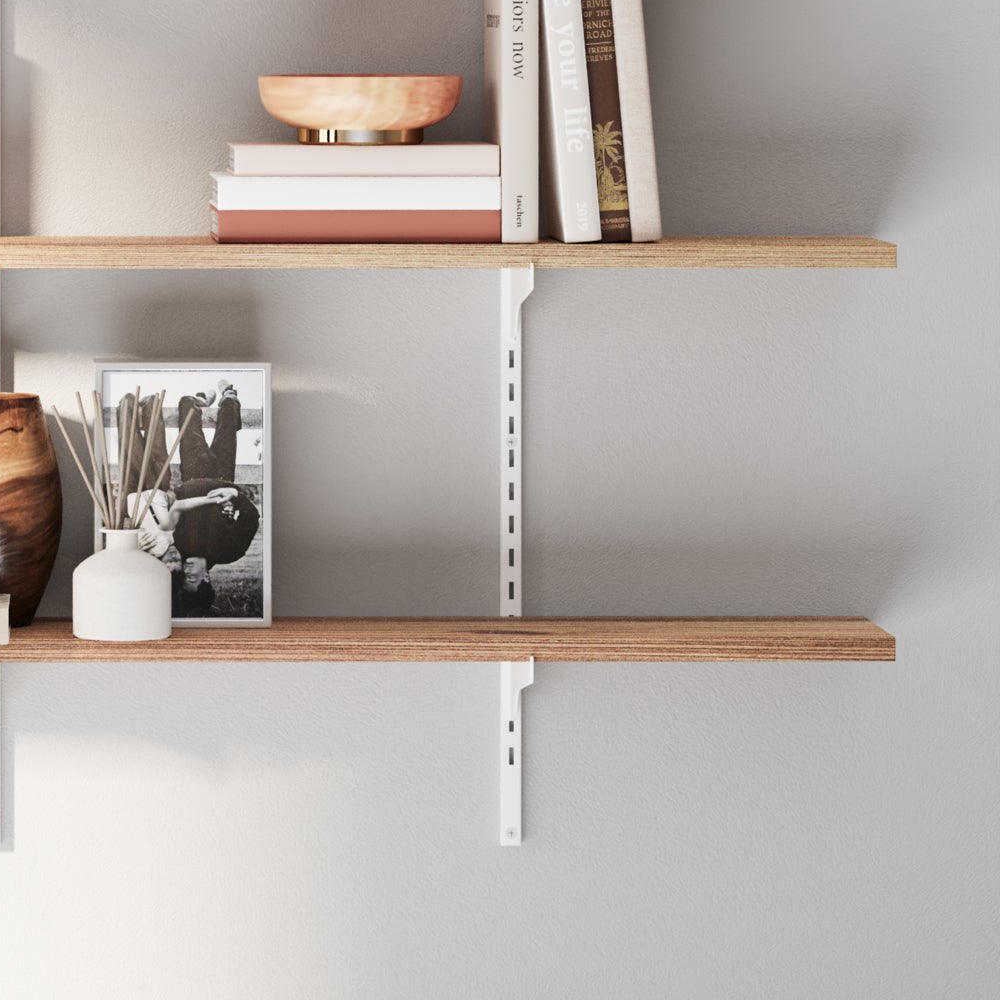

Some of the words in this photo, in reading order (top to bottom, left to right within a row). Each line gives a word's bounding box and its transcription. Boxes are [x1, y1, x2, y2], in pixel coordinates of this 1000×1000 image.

[586, 30, 612, 39] ROAD
[513, 41, 523, 80] now
[552, 24, 577, 91] your
[563, 106, 590, 154] life
[577, 202, 588, 231] 2019
